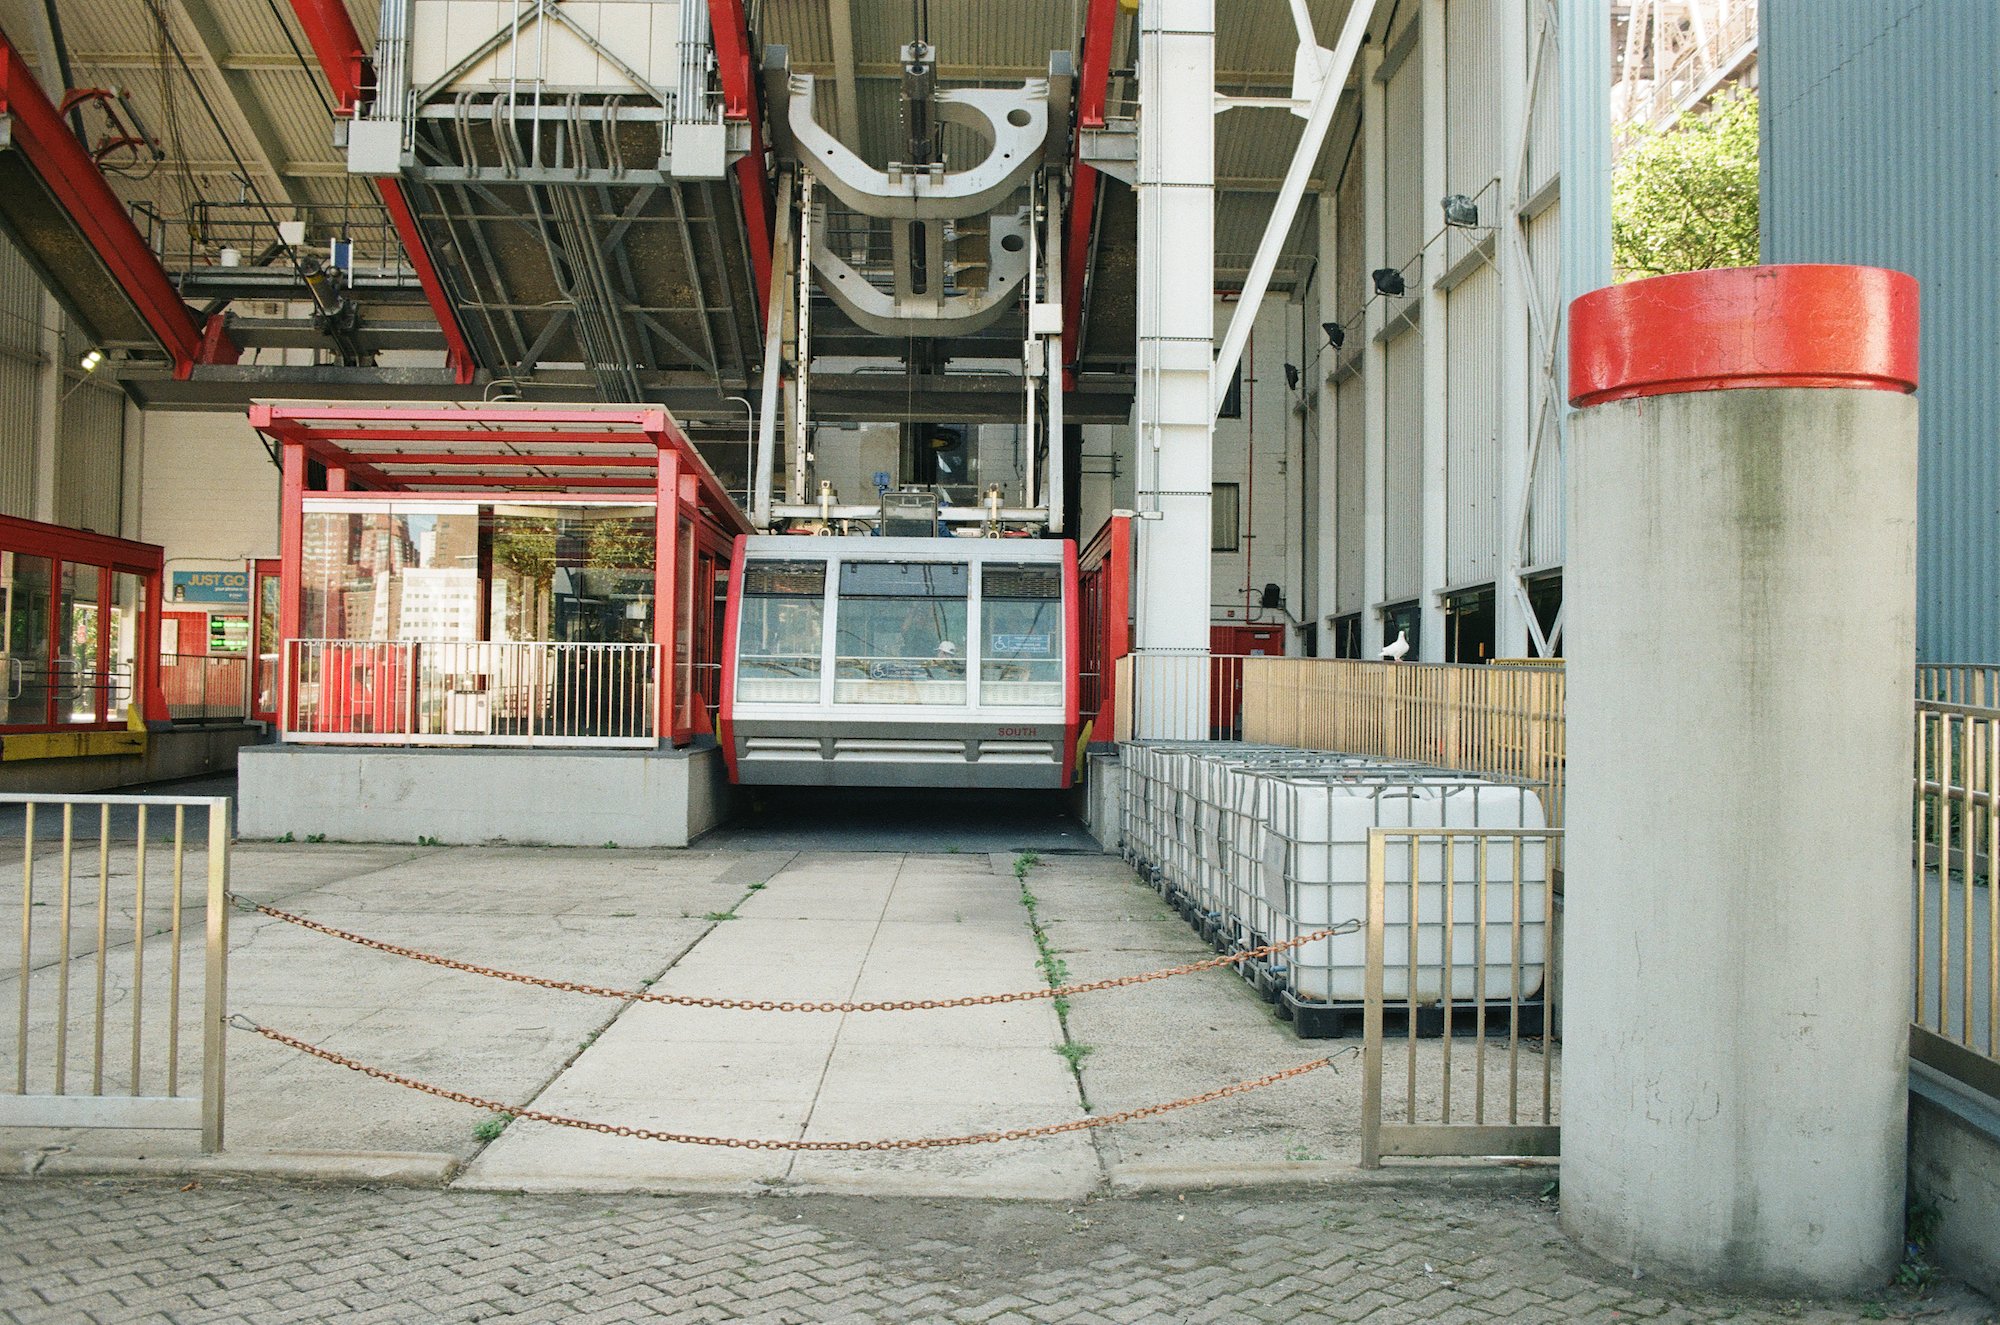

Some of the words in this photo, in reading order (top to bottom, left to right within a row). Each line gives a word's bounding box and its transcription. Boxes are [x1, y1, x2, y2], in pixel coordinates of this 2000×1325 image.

[188, 574, 221, 586] JUST
[223, 575, 245, 586] GO
[998, 727, 1037, 737] SOUTH
